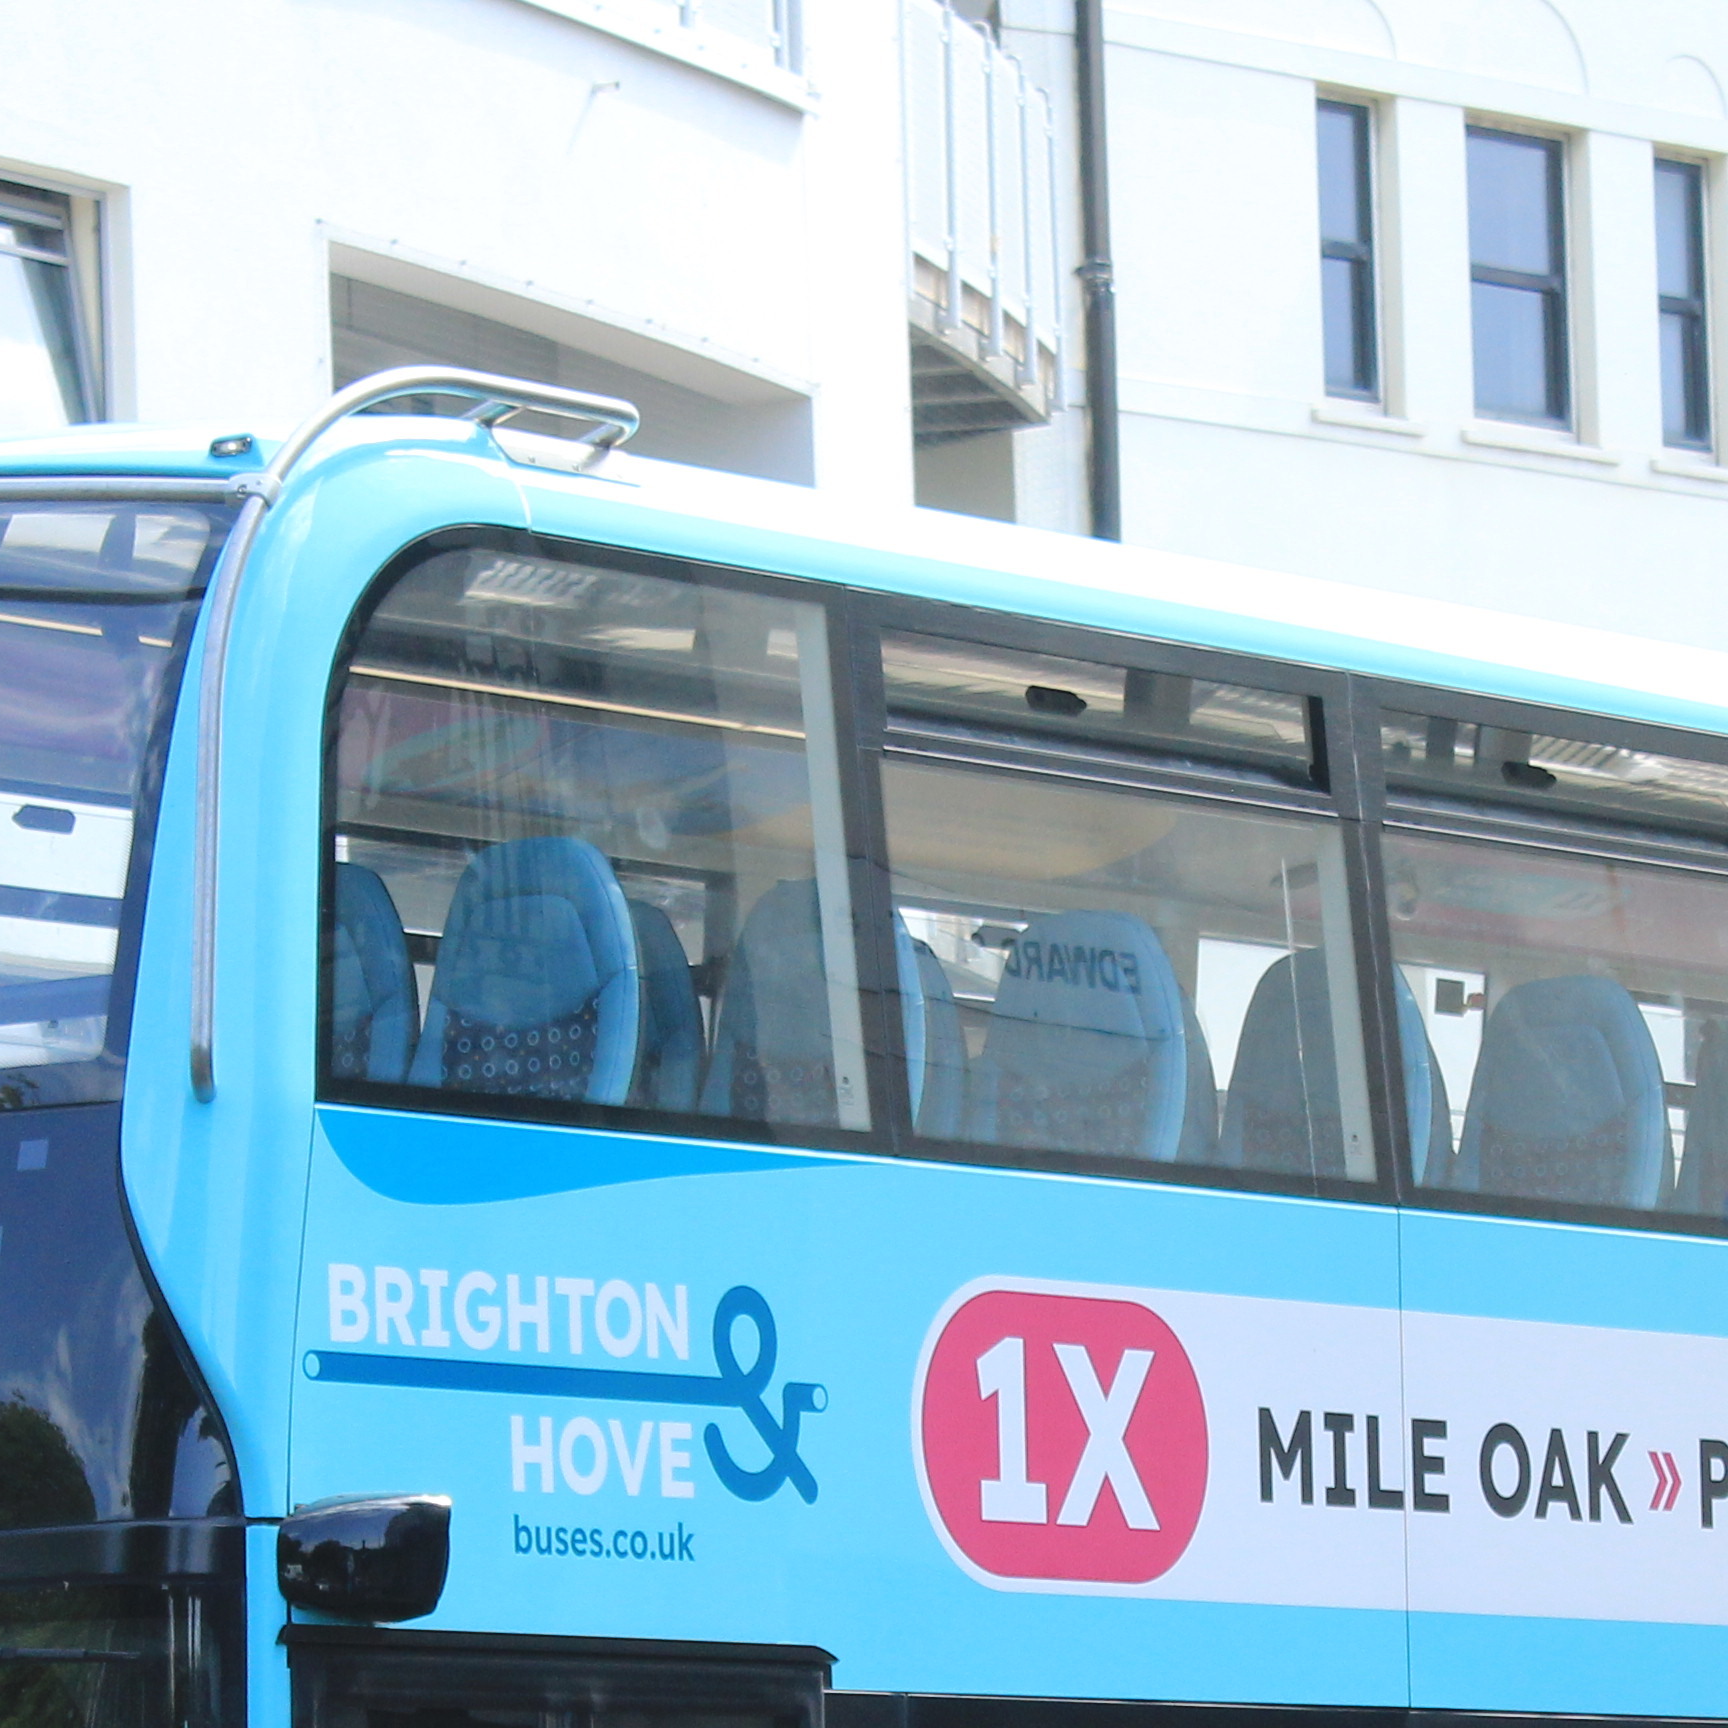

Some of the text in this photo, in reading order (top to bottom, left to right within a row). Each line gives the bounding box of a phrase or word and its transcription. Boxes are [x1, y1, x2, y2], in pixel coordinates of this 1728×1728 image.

[327, 1263, 690, 1361] BRIGHTON
[509, 1414, 695, 1499] HOVE
[975, 1335, 1162, 1532] 1X
[1257, 1406, 1451, 1515] MILE
[1478, 1421, 1635, 1526] OAK
[513, 1514, 696, 1562] buses.co.uk
